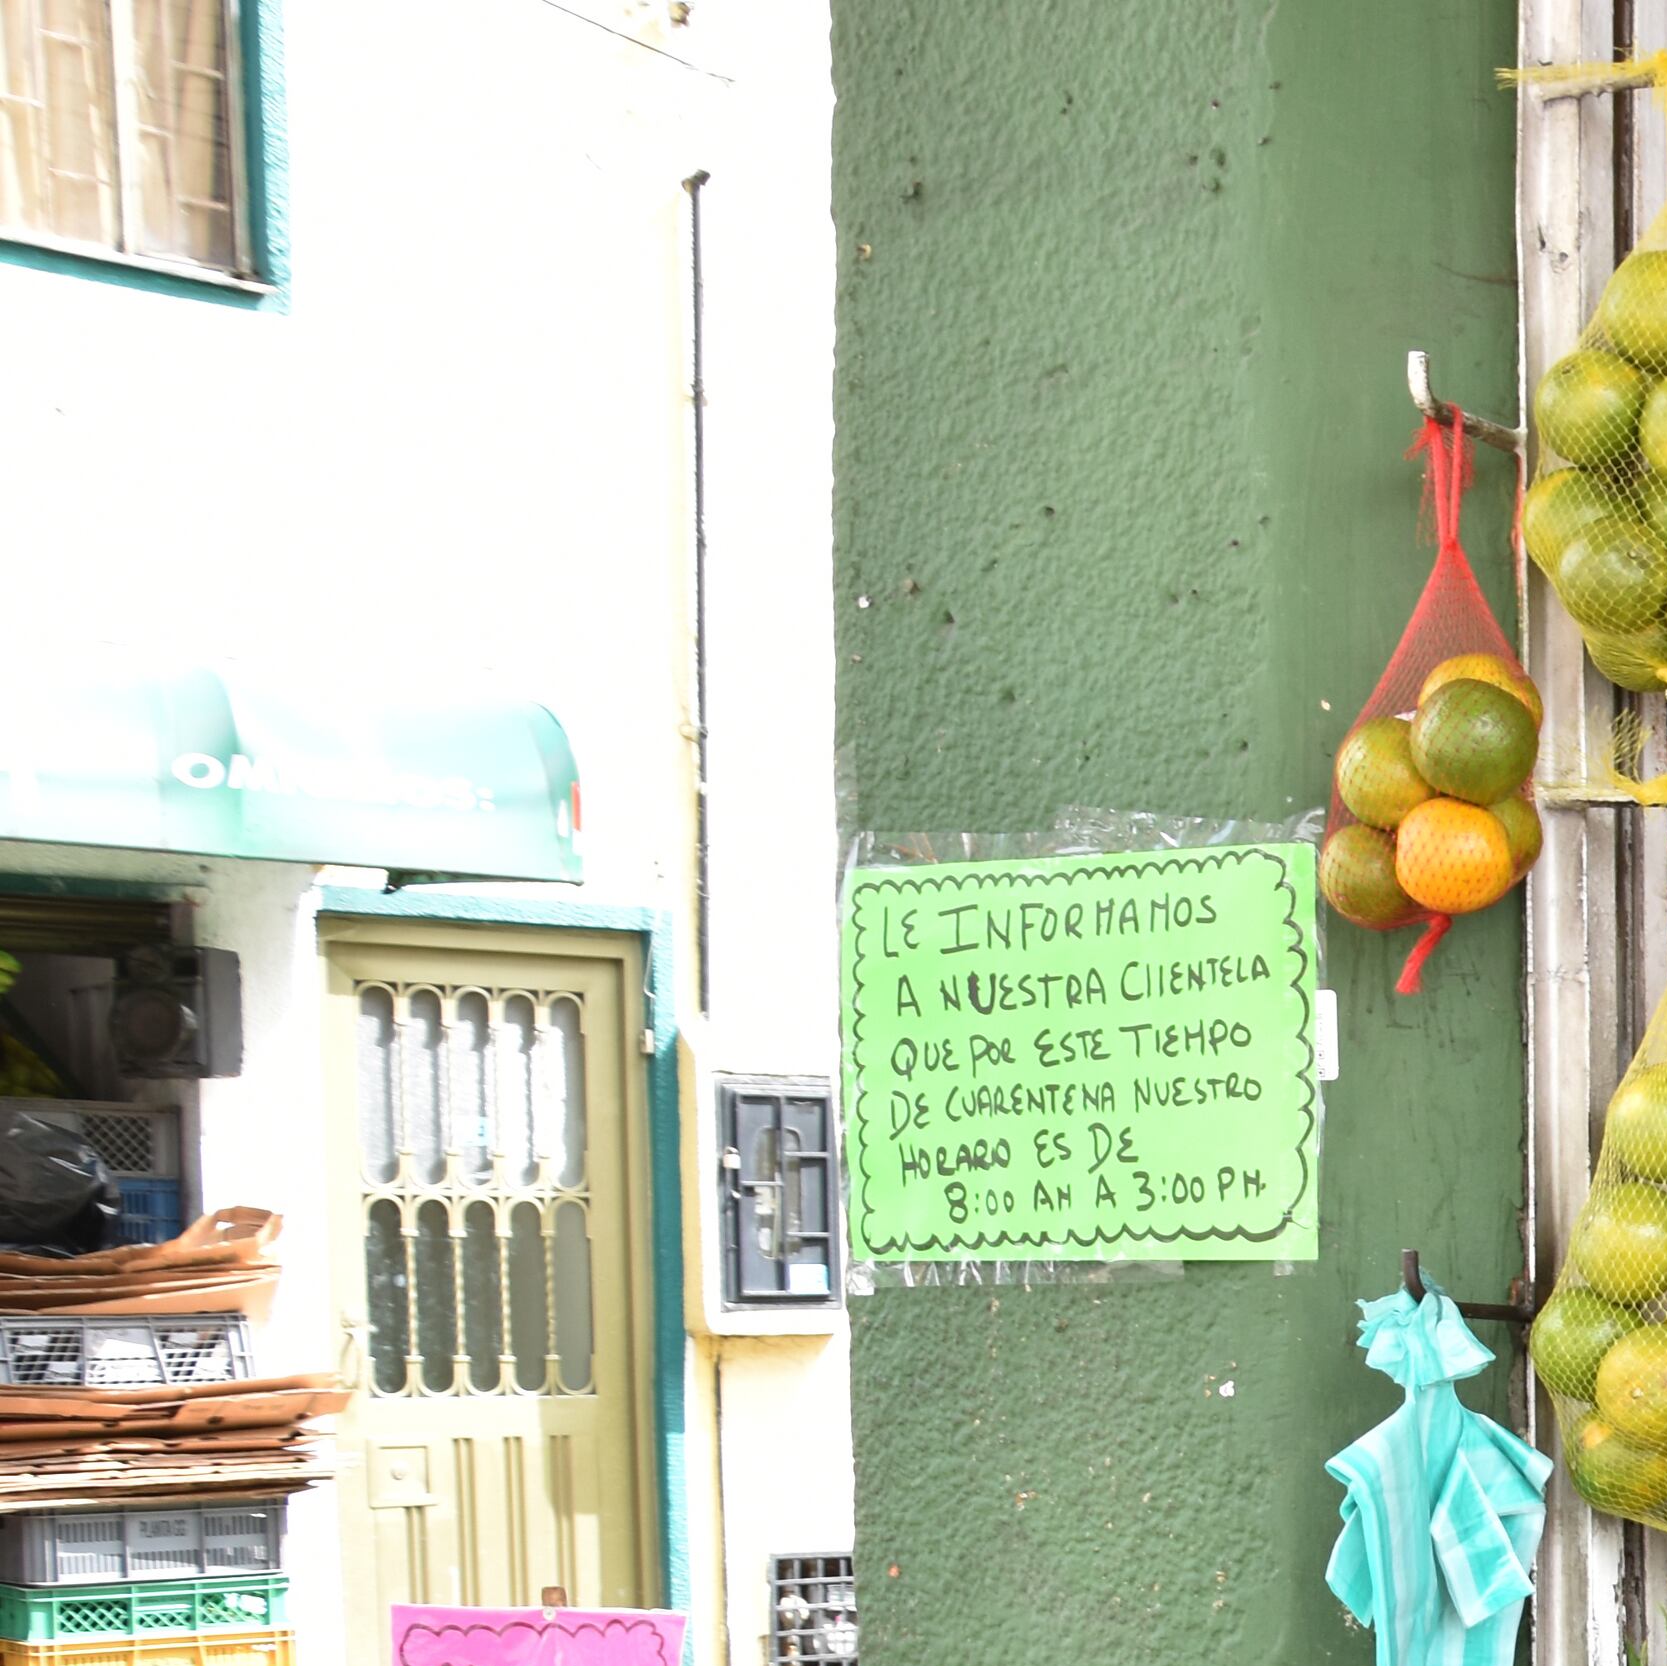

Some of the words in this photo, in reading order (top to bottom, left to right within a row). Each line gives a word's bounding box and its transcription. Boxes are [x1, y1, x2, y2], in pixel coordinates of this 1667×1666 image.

[883, 907, 919, 957] LE
[938, 894, 1217, 955] INFORMAMOS
[897, 974, 921, 1017] A
[940, 967, 1107, 1014] NUESTRA
[1120, 954, 1271, 1001] CLIENTELA
[890, 1037, 960, 1082] QUE
[970, 1033, 1017, 1078] POR
[1033, 1027, 1112, 1067] ESTE
[1119, 1021, 1252, 1059] TIEMPO
[889, 1090, 931, 1140] DE
[944, 1082, 1116, 1122] CUARENTENA
[1133, 1072, 1263, 1113] NUESTRO
[1033, 1128, 1073, 1169] ES
[1088, 1123, 1139, 1174] DE
[943, 1183, 1016, 1224] 8:00
[1033, 1179, 1072, 1211] AM
[1095, 1174, 1117, 1209] A
[1132, 1170, 1206, 1212] 3:00
